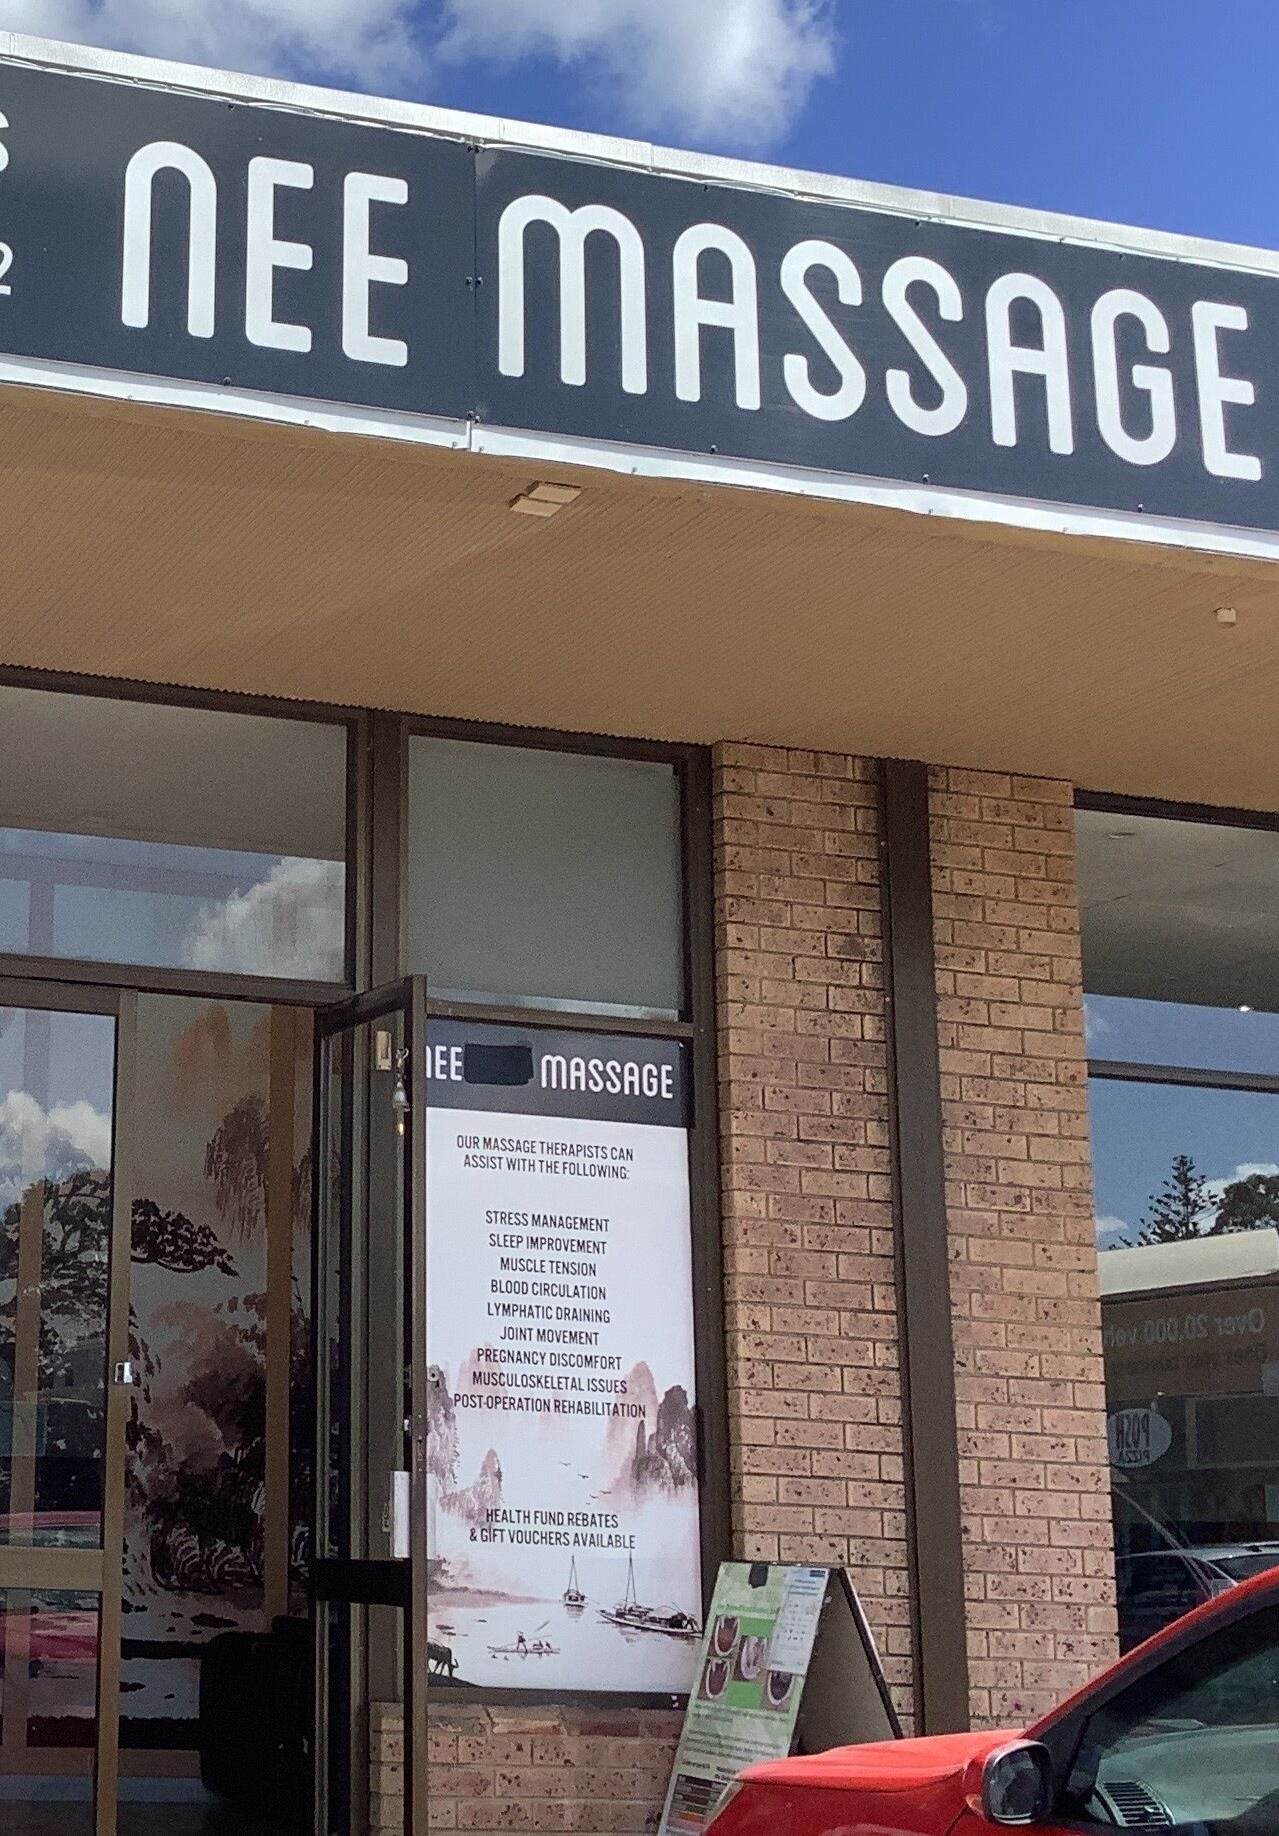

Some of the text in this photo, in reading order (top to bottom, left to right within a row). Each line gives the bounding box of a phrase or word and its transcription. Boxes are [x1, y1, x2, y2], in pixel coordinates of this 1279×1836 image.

[122, 140, 1264, 481] NEE MASSAGE
[541, 1054, 674, 1099] MASSAGE
[457, 1134, 633, 1161] OUR MASSAGE THERAPISTS CAN
[464, 1154, 630, 1180] ASSIST WITH THE FOLLOWING:
[486, 1210, 609, 1232] STRESS MANAGEMENT
[489, 1233, 607, 1254] SLEEP IMPROVEMENT
[500, 1257, 597, 1276] MUSCLE TENSION
[491, 1280, 606, 1300] BLOOD CIRCULATION
[487, 1303, 610, 1324] LYMPHATIC DRAINING
[500, 1326, 599, 1346] JOINT MOVEMENT
[477, 1348, 621, 1370] PREGNANCY DISCOMFORT
[472, 1372, 627, 1394] MUSCULOSKELETAL ISSUES
[454, 1394, 646, 1418] POST-OPERATION REHABILITATION
[486, 1508, 618, 1528] HEALTH FUND REBATES
[470, 1529, 636, 1549] & GIFT VOUCHERS AVAILABLE
